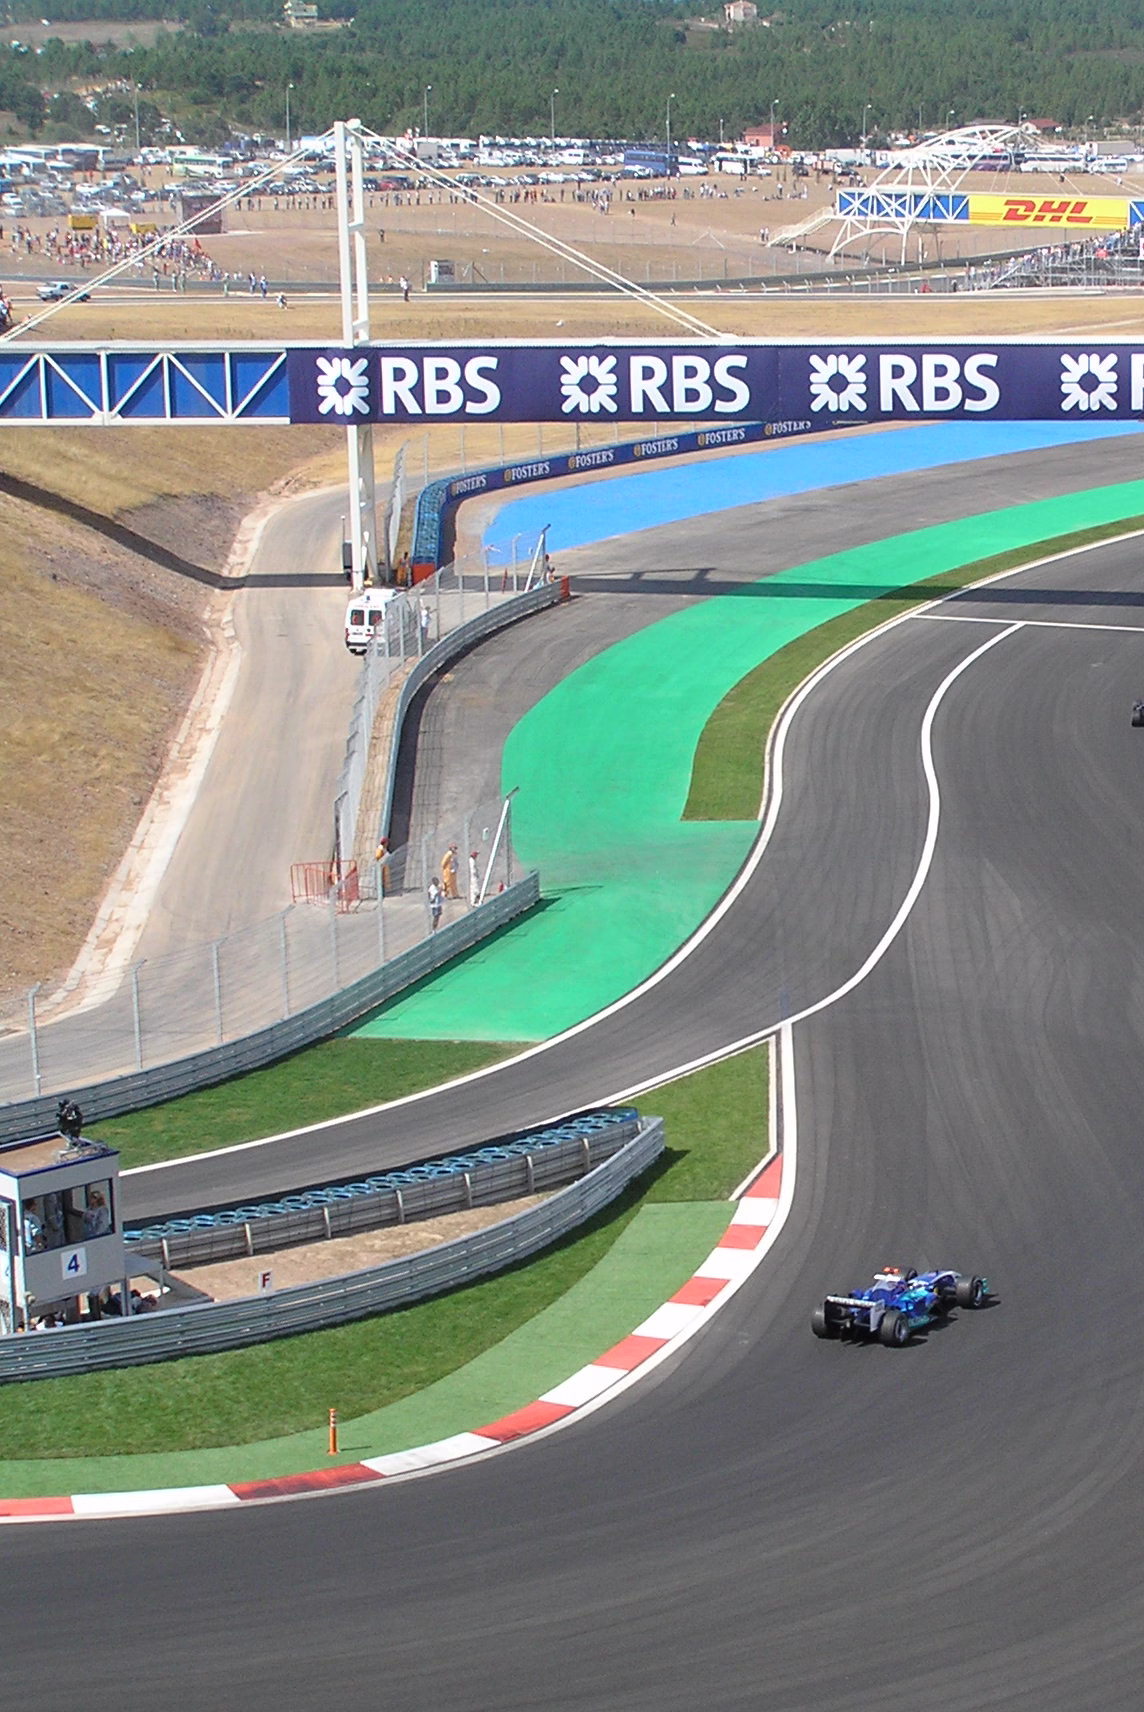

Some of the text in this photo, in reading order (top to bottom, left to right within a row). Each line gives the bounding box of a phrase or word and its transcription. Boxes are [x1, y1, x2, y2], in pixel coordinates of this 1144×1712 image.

[1003, 199, 1094, 224] DHL
[381, 356, 501, 414] RBS
[630, 355, 750, 413] RBS
[880, 354, 1000, 412] RBS
[705, 427, 746, 445] FOSTER'S
[641, 438, 679, 456] FOSTER'S
[575, 449, 615, 468] FOSTER'S
[511, 461, 550, 480] FOSTER'S
[67, 1254, 80, 1272] 4
[262, 1272, 271, 1287] F
